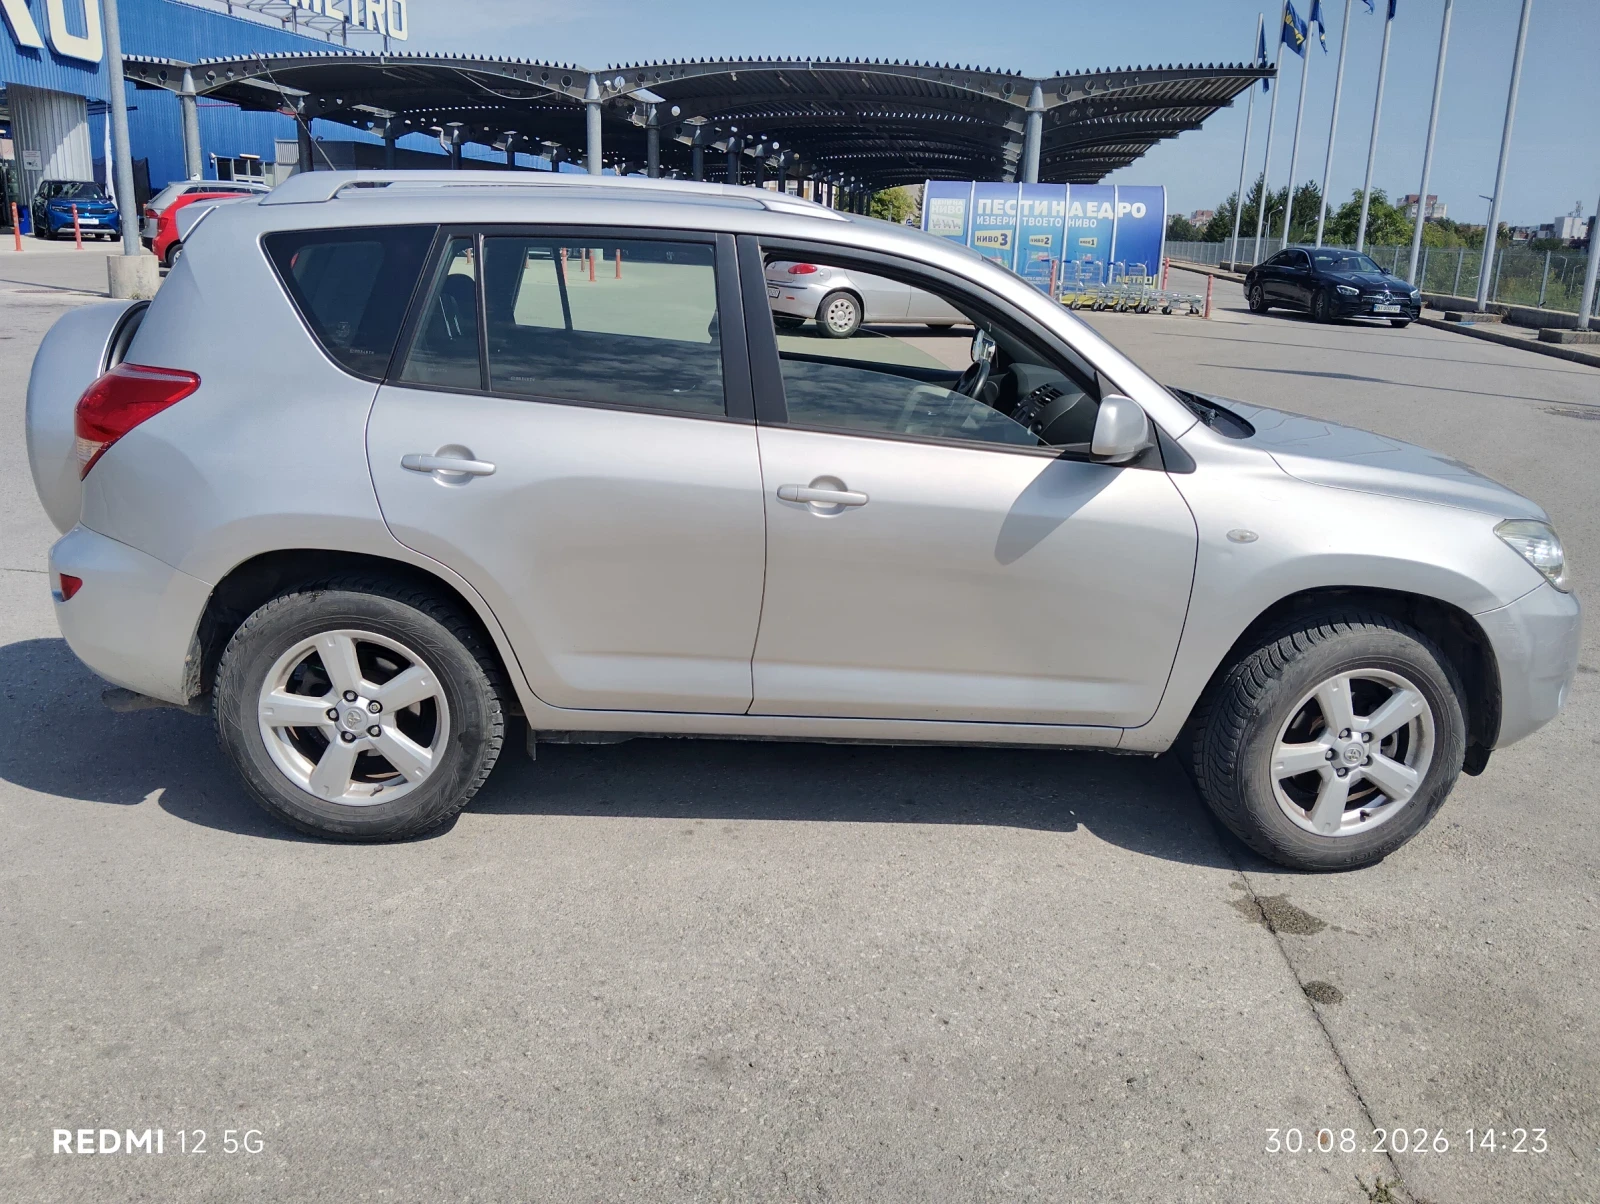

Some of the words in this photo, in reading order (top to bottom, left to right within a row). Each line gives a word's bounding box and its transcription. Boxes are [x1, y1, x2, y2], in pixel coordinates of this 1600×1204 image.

[931, 205, 963, 214] НИВО
[977, 198, 1048, 216] ПЕСТИ
[1051, 200, 1084, 217] НА
[1086, 201, 1147, 220] ЕДРО
[976, 215, 1017, 226] ИЗБЕРИ
[1022, 217, 1062, 227] ТВОЕТО
[1068, 219, 1097, 228] НИВО
[976, 235, 999, 243] НИВО
[999, 233, 1008, 246] 3
[1044, 236, 1050, 245] 2
